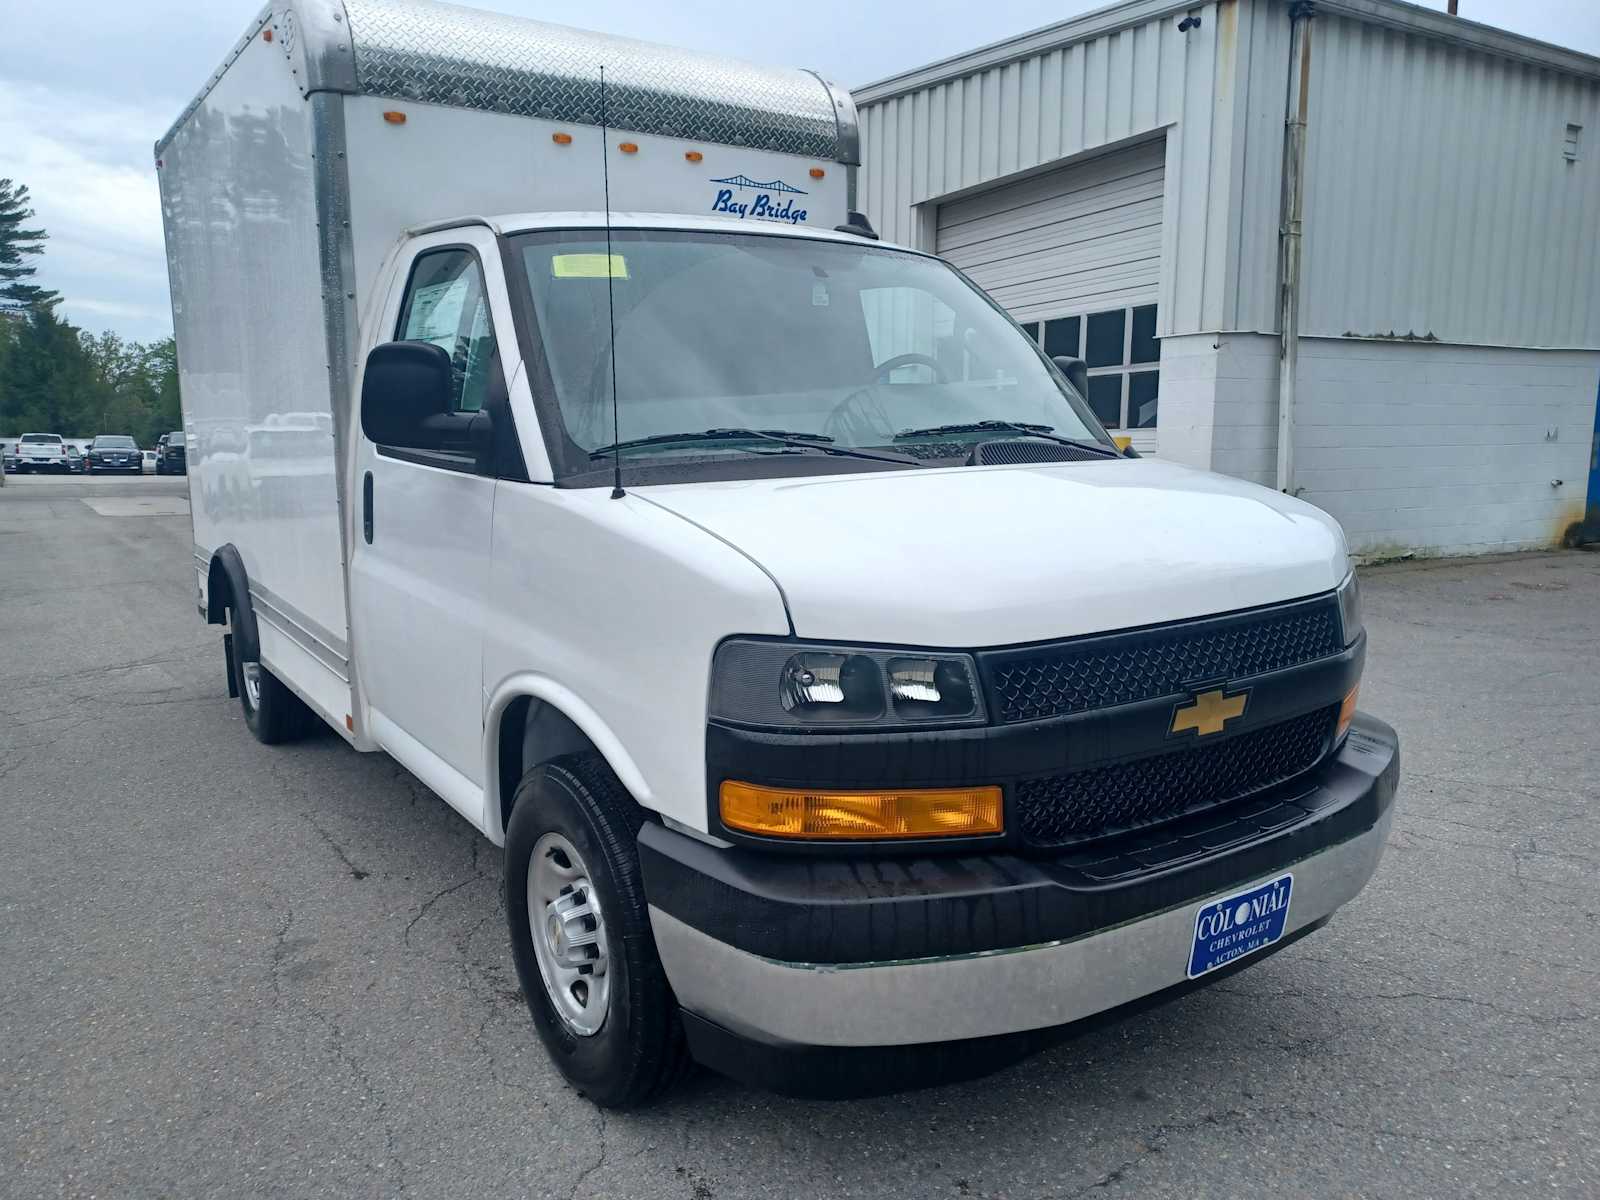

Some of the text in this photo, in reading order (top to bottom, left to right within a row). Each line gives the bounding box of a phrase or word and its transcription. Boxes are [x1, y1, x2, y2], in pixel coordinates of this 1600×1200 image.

[711, 189, 807, 224] Bay Bridge
[1198, 886, 1287, 940] COLONIAL
[1209, 919, 1271, 952] CHEVROLET
